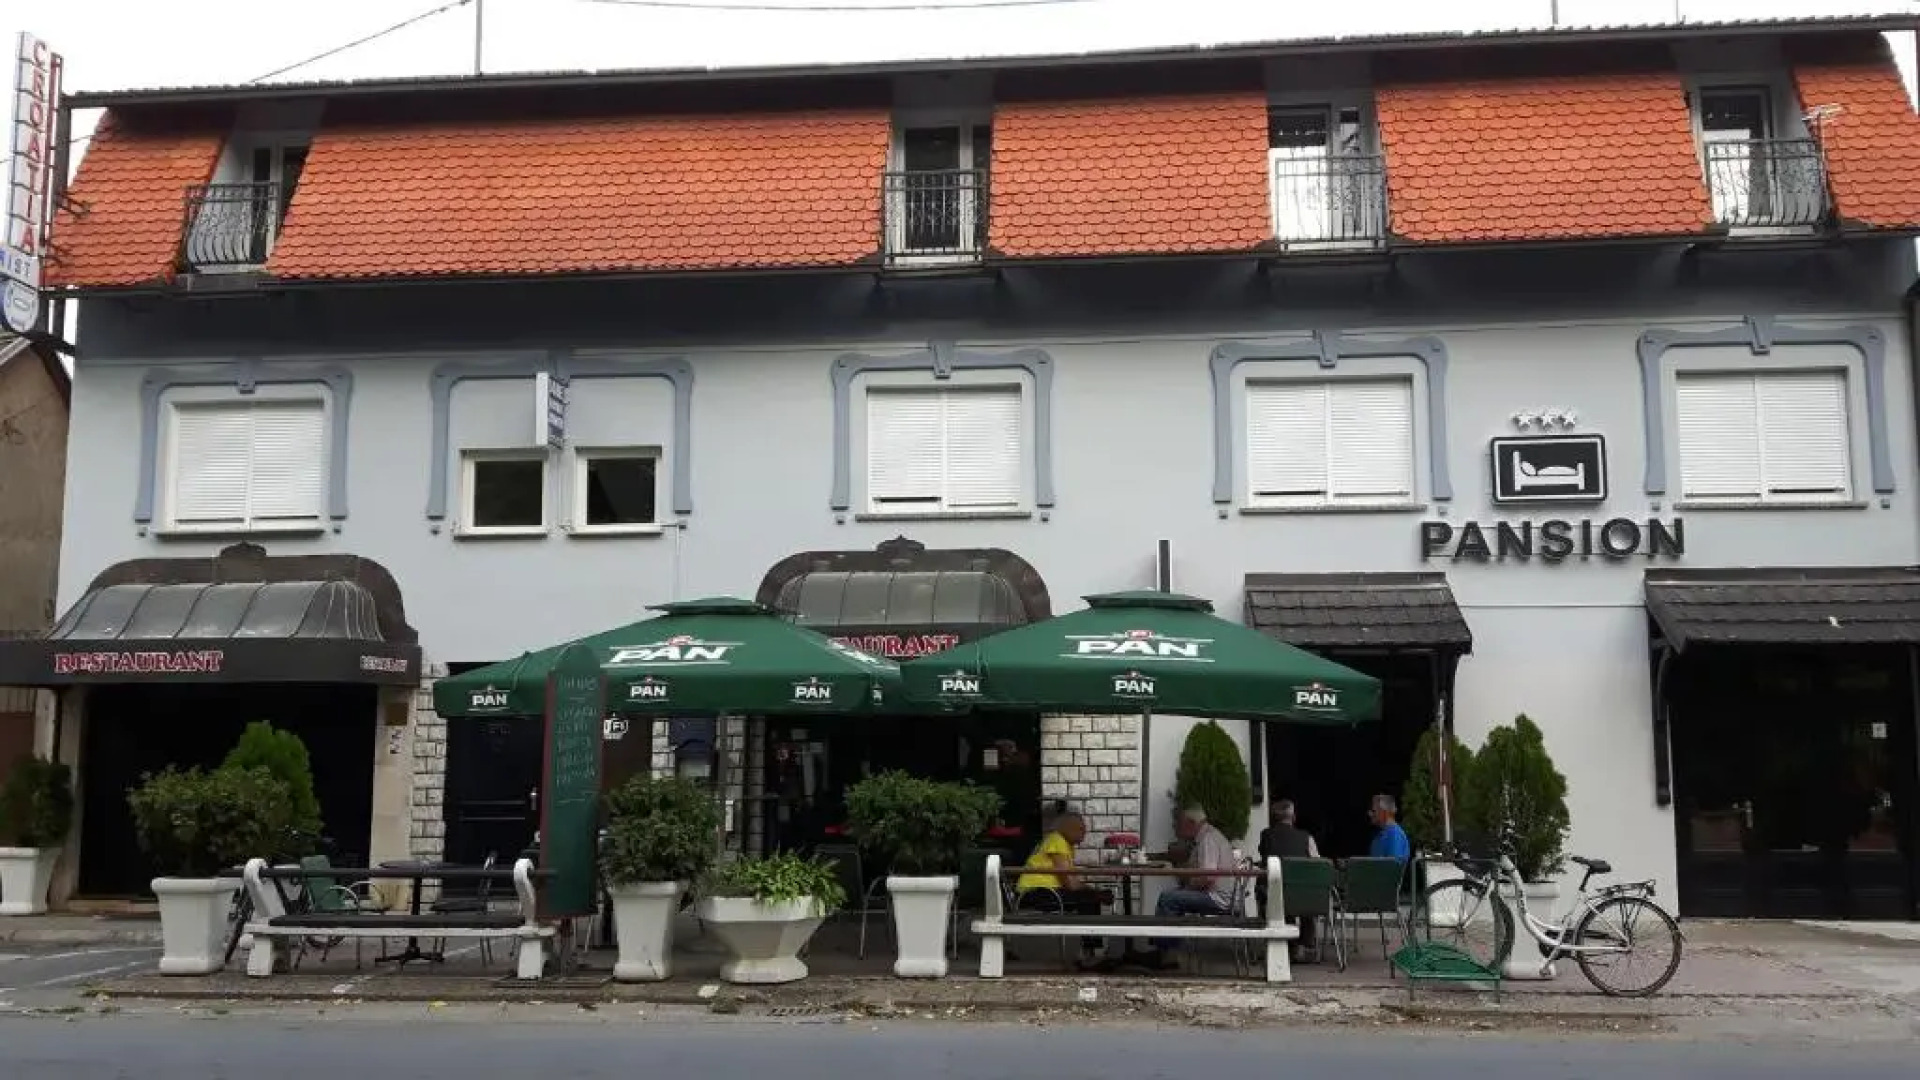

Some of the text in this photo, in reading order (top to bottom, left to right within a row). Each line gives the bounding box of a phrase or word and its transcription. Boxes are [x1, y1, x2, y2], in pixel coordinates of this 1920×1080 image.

[20, 39, 47, 255] CROATIA
[1420, 517, 1685, 558] PANSION
[608, 645, 729, 663] PAN
[1077, 640, 1200, 657] PAN
[54, 650, 224, 674] RESTAURANT
[629, 685, 667, 698] PAN
[794, 685, 831, 699] PAN
[941, 678, 980, 692] PAN
[1114, 680, 1154, 694] PAN
[471, 692, 508, 706] PAN
[1296, 690, 1337, 706] PAN
